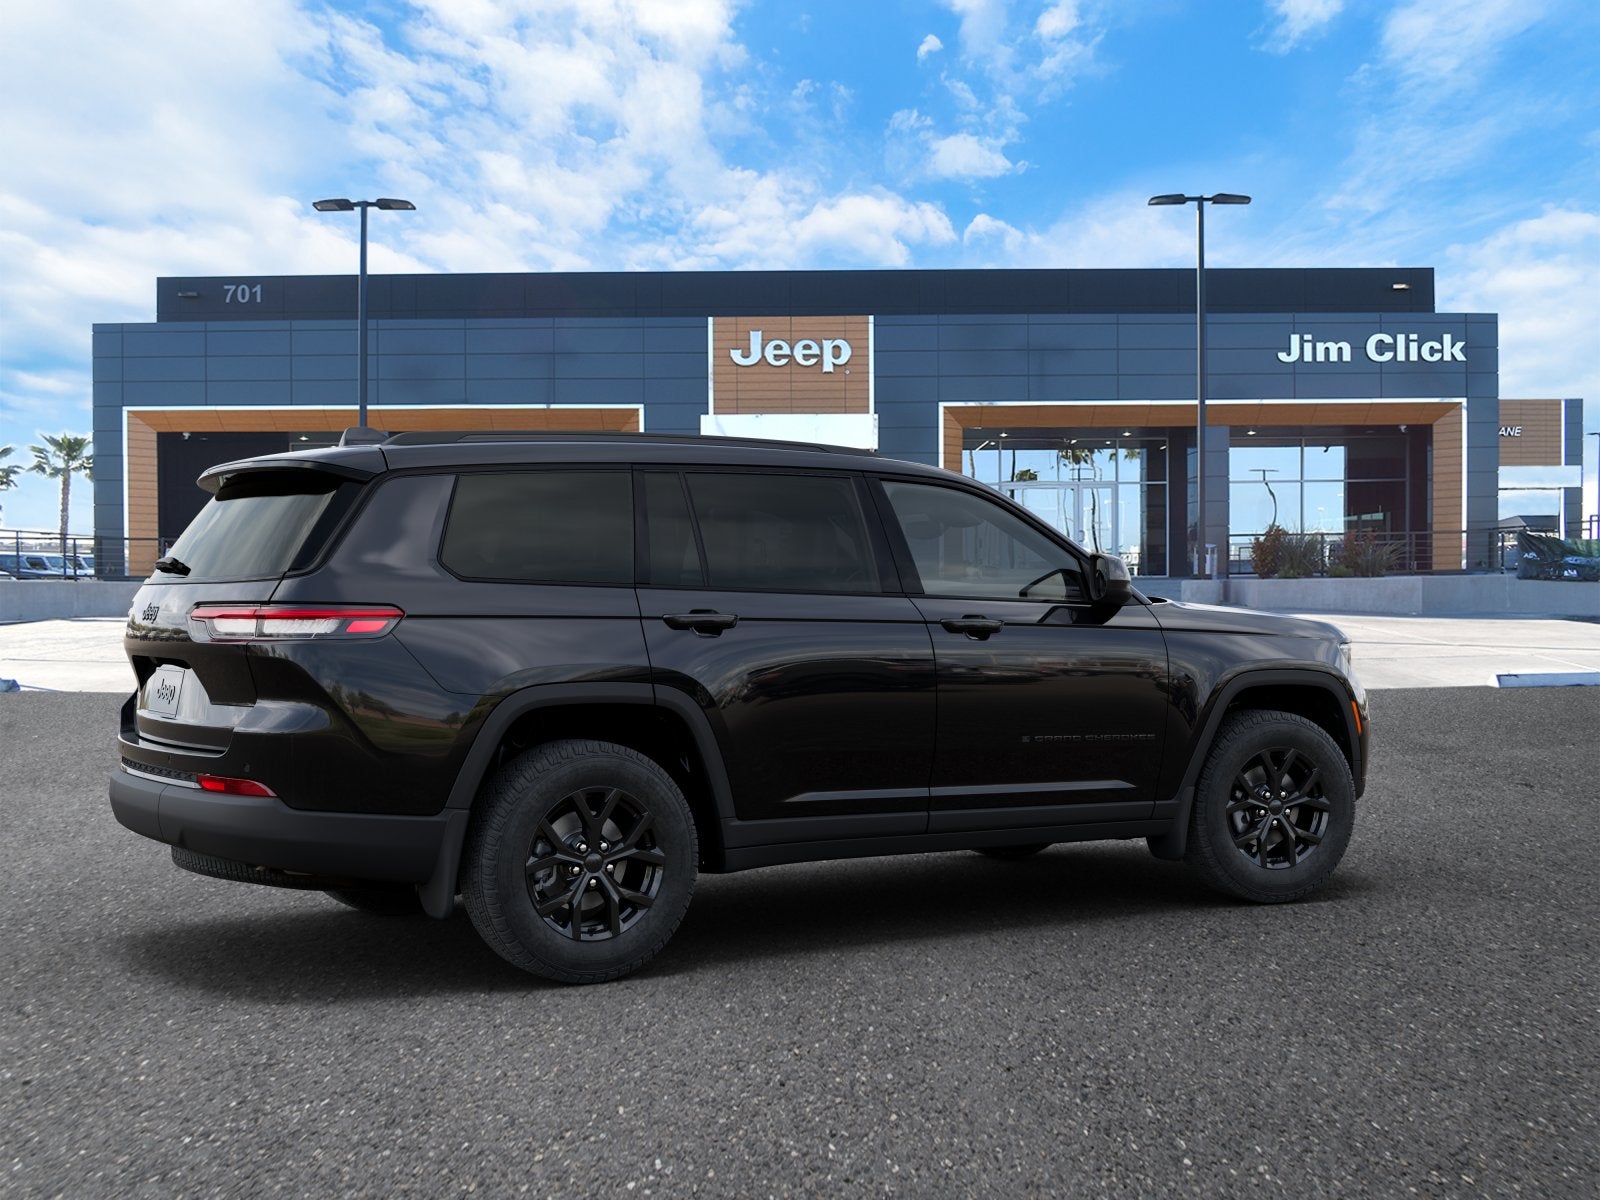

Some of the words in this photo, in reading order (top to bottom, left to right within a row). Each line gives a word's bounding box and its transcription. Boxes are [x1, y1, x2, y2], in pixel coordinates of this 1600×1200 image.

[223, 284, 262, 303] 701
[729, 329, 852, 373] Jeep
[1277, 333, 1352, 363] Jim
[1365, 332, 1467, 363] Click
[156, 678, 176, 704] Jeep
